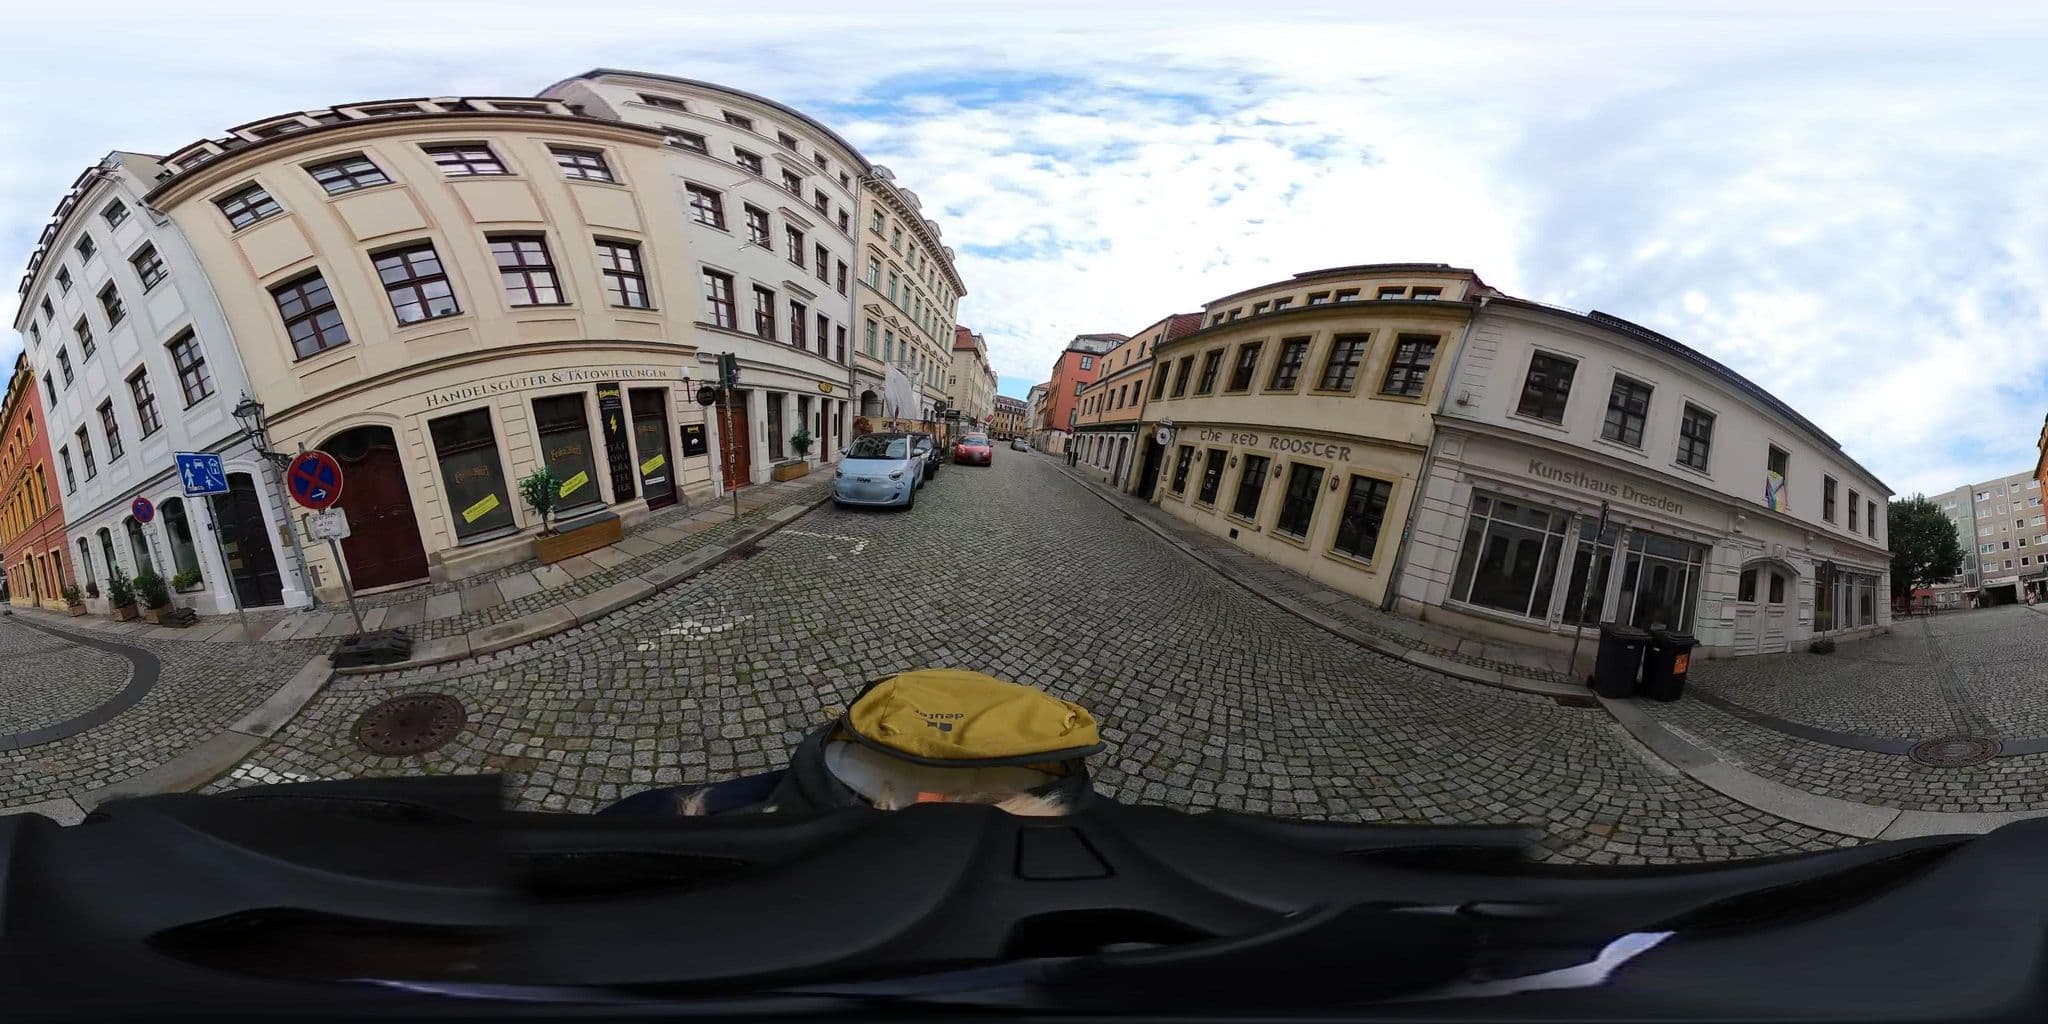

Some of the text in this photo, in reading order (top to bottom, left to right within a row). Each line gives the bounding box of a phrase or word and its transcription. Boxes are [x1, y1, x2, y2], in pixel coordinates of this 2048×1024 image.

[426, 375, 547, 407] HANDELSGÜTER
[551, 372, 562, 383] &
[1230, 431, 1259, 446] RED
[1269, 436, 1352, 462] ROOSTER
[1528, 459, 1684, 515] Kunsthaus Dresden
